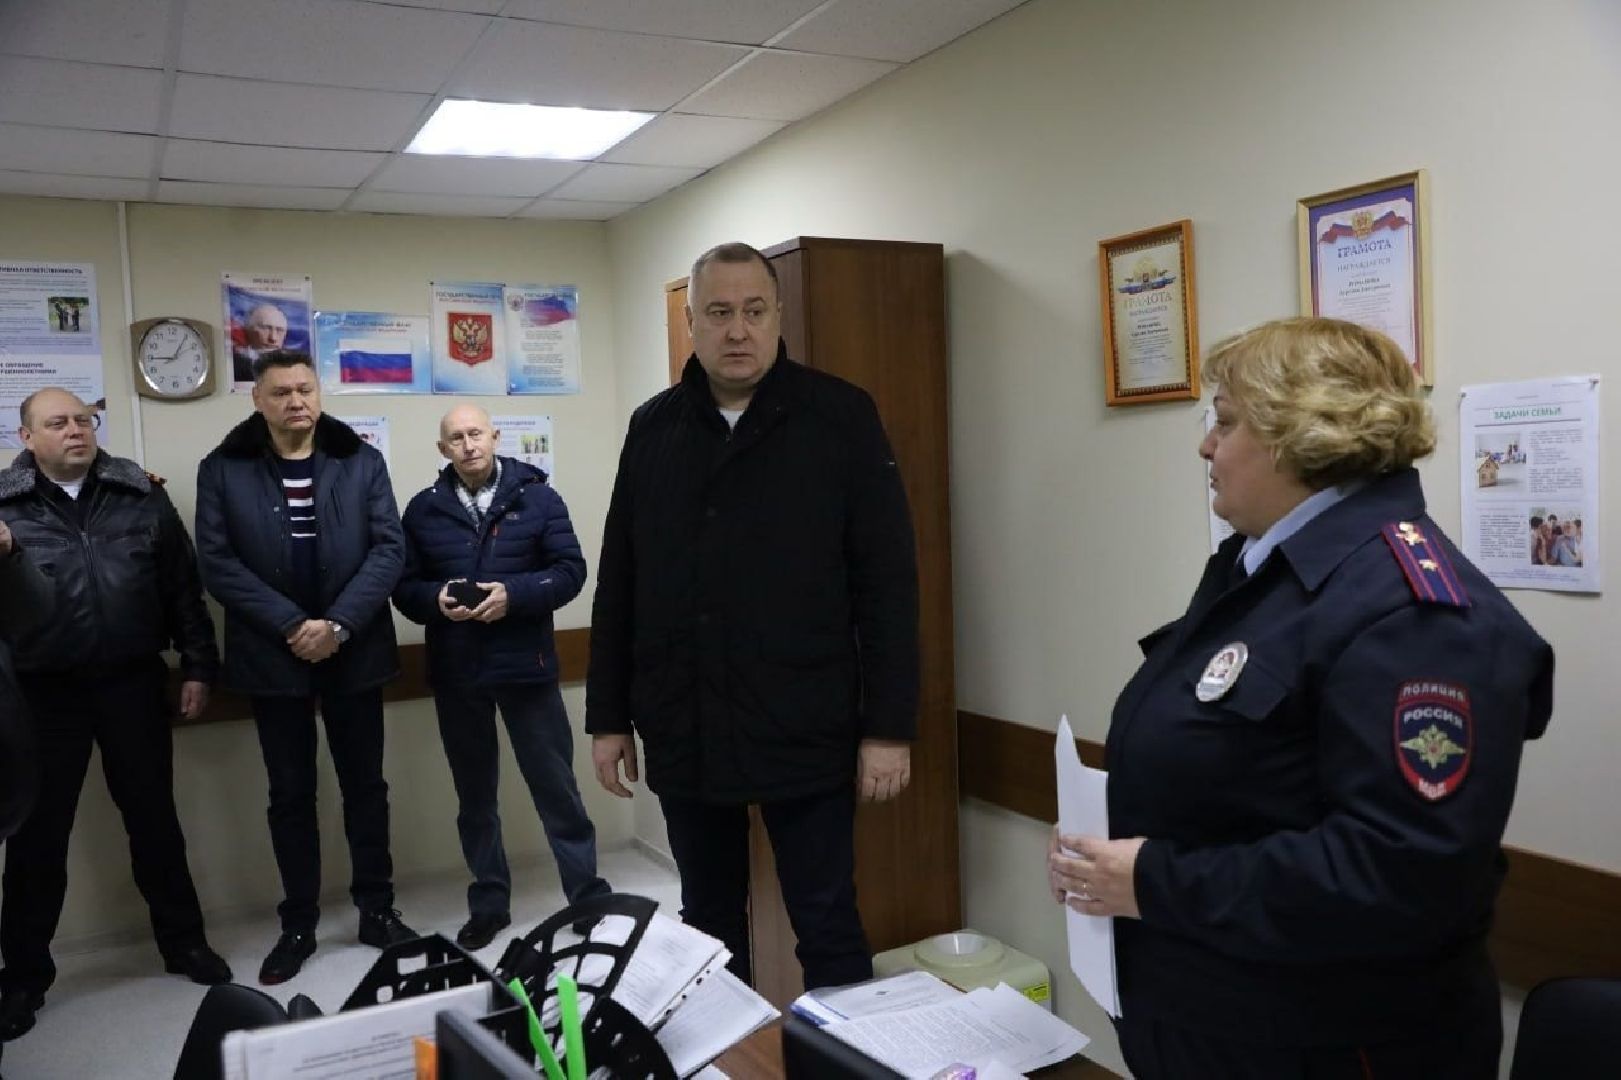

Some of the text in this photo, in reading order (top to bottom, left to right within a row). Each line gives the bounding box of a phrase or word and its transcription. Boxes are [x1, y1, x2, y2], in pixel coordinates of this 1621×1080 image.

[1337, 240, 1392, 258] ГРАМОТА
[1123, 292, 1172, 309] ГРАМОТА
[168, 326, 177, 335] 12
[1494, 407, 1561, 420] ЗАДАЧИ СЕМЬИ
[1403, 683, 1464, 701] ПОЛИЦИЯ
[1404, 708, 1463, 729] РОССИЯ
